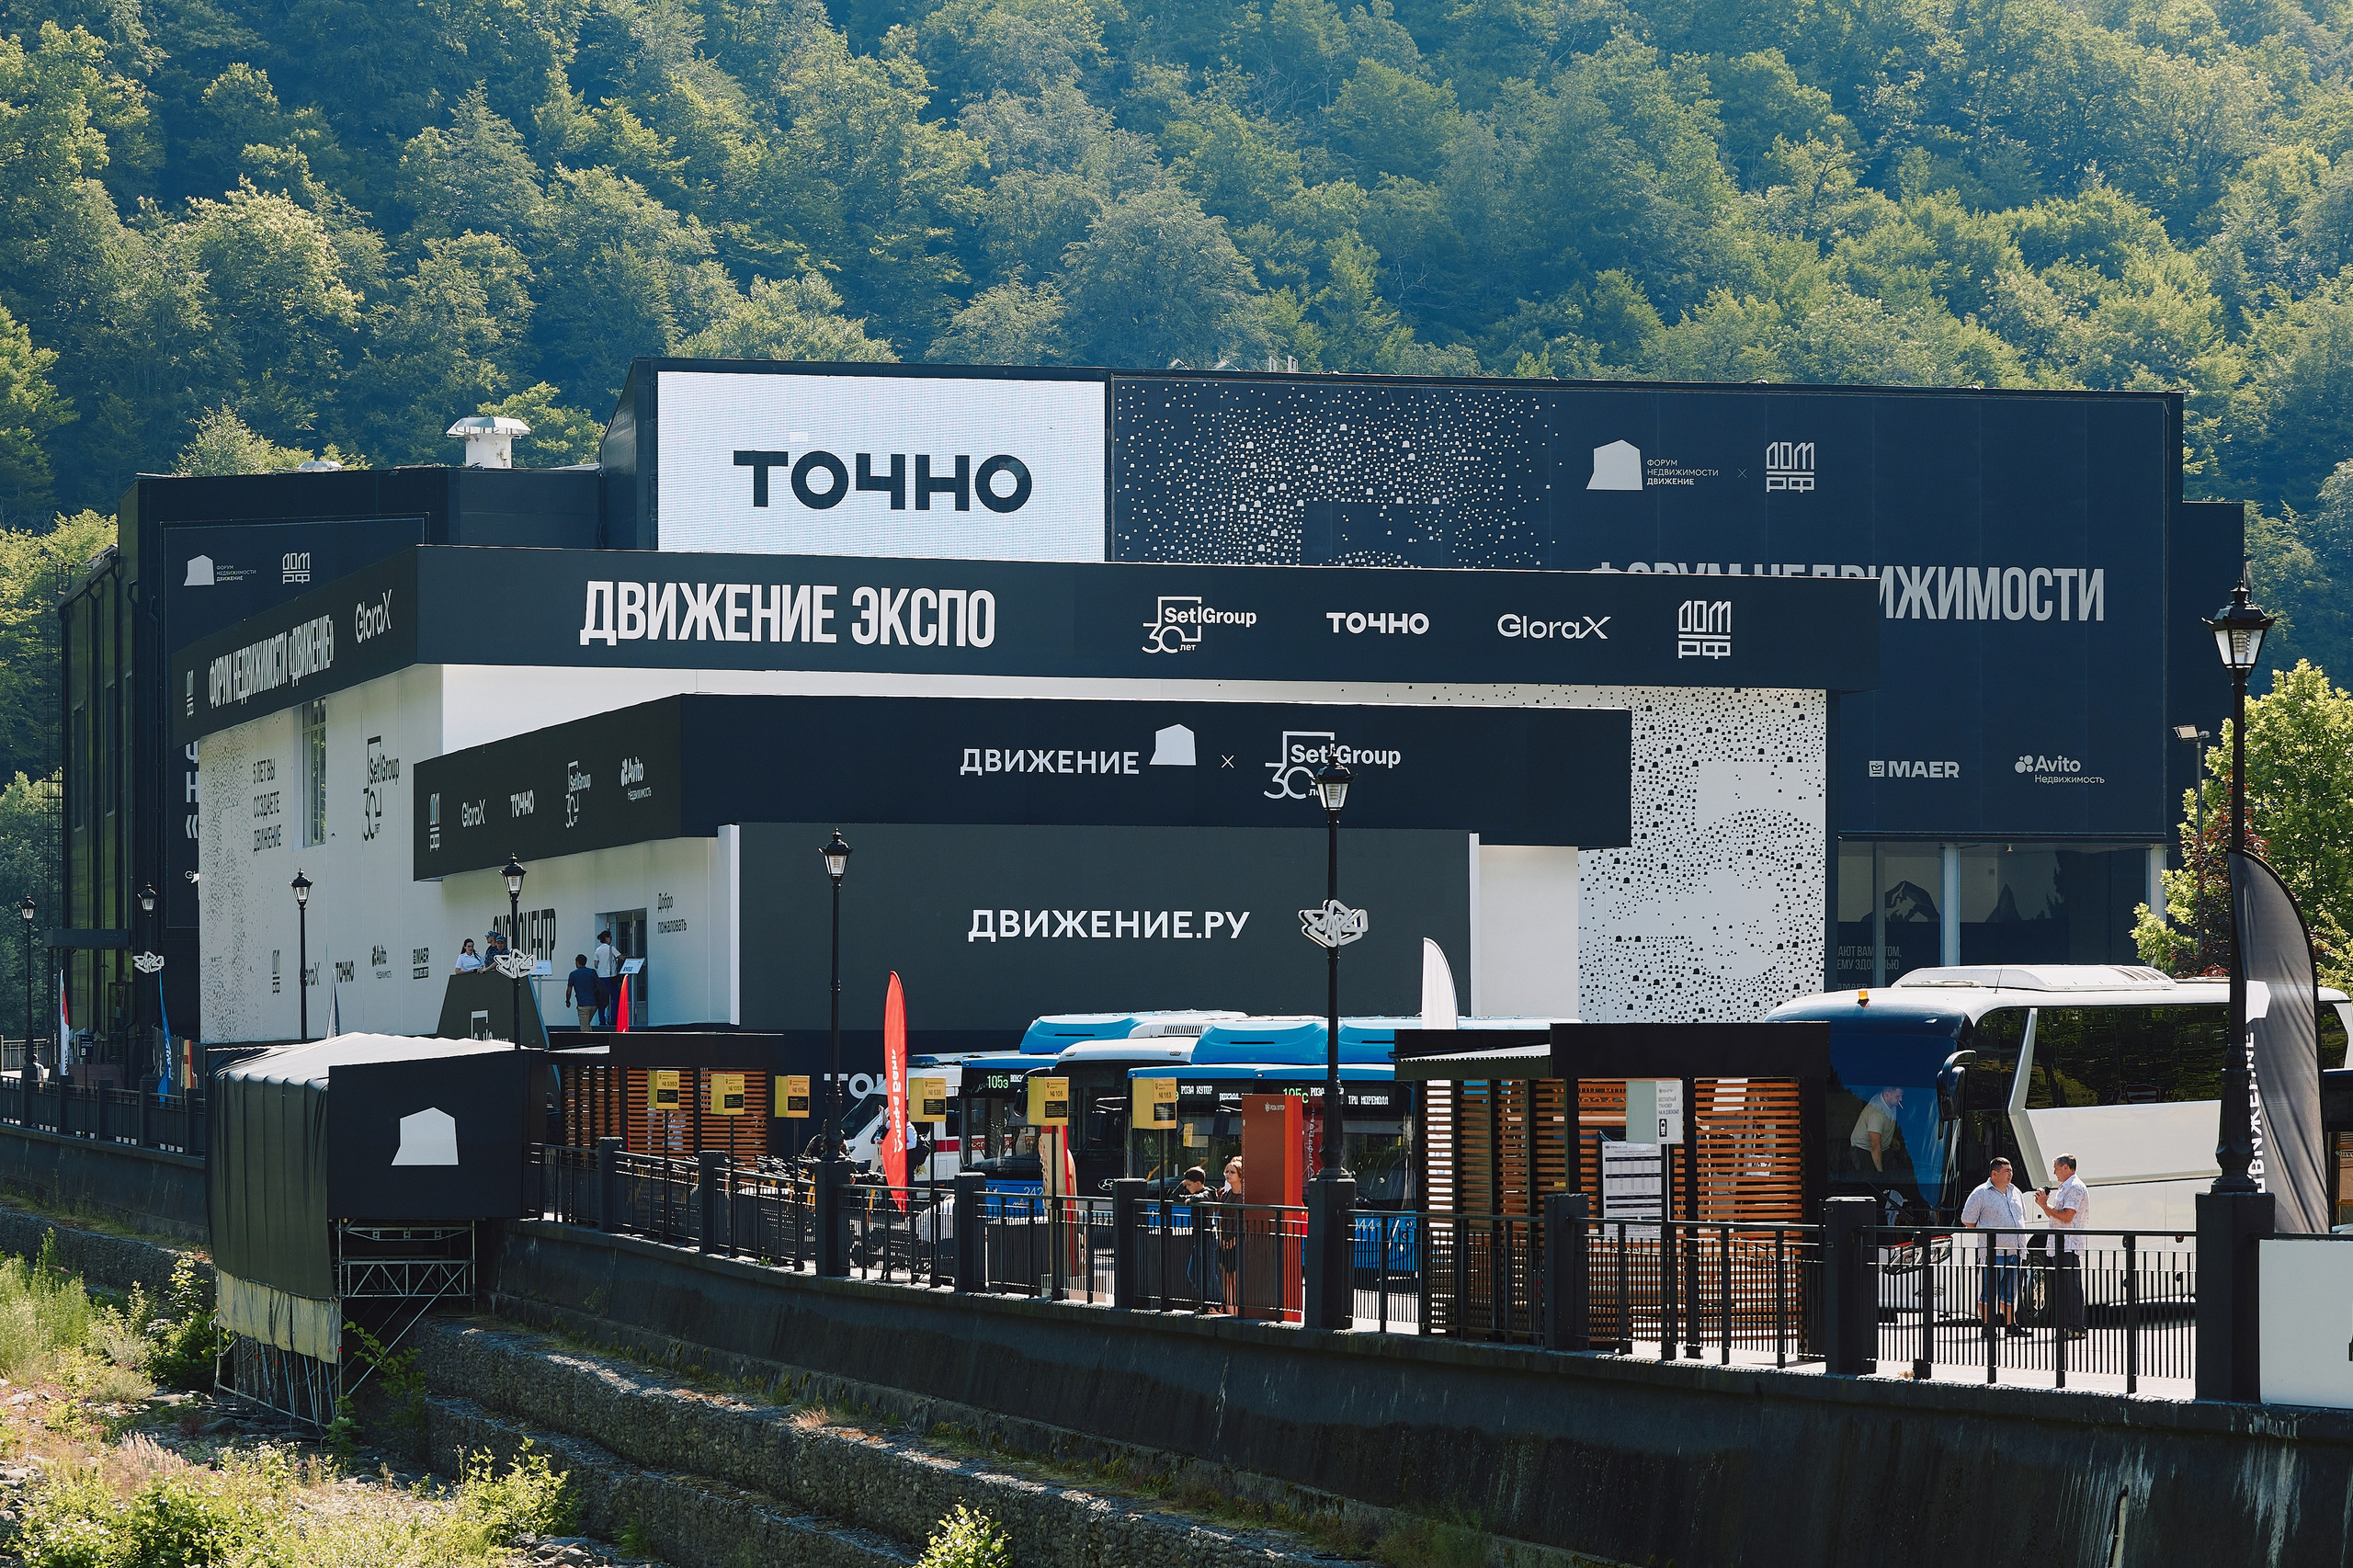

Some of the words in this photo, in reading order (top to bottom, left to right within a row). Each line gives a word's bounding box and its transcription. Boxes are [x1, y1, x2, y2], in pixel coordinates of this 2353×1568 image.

[1646, 459, 1678, 467] ФОРУМ
[1767, 442, 1814, 470] ДОМ
[733, 449, 1032, 513] ТОЧНО
[1646, 468, 1720, 477] НЕДВИЖИМОСТИ
[1646, 478, 1695, 486] ДВИЖЕНИЕ
[1767, 477, 1815, 493] РФ
[282, 552, 310, 570] ДОМ
[282, 574, 310, 584] РФ
[1754, 563, 2105, 621] ИЖИМОСТИ
[356, 589, 392, 643] GloraX
[579, 581, 837, 646] ДВИЖЕНИЕ
[851, 586, 996, 648] ЭКСПО
[1326, 612, 1429, 635] ТОЧНО
[1678, 600, 1731, 632] ДОМ
[1497, 613, 1611, 640] GloraX
[1179, 643, 1197, 652] лет
[1678, 641, 1731, 659] РФ
[210, 661, 232, 709] ФОРУМ
[233, 631, 287, 705] НЕДВИЖИМОСТИ
[628, 756, 643, 783] Avito
[960, 749, 1140, 776] ДВИЖЕНИЕ
[1888, 761, 1960, 778] MAER
[2035, 756, 2081, 773] Avito
[2034, 775, 2105, 785] Недвижимость
[461, 799, 486, 827] GloraX
[510, 790, 534, 818] ТОЧНО
[658, 892, 674, 914] Добро
[658, 919, 688, 934] пожаловать
[968, 909, 1251, 943] ДВИЖЕНИЕ.РУ
